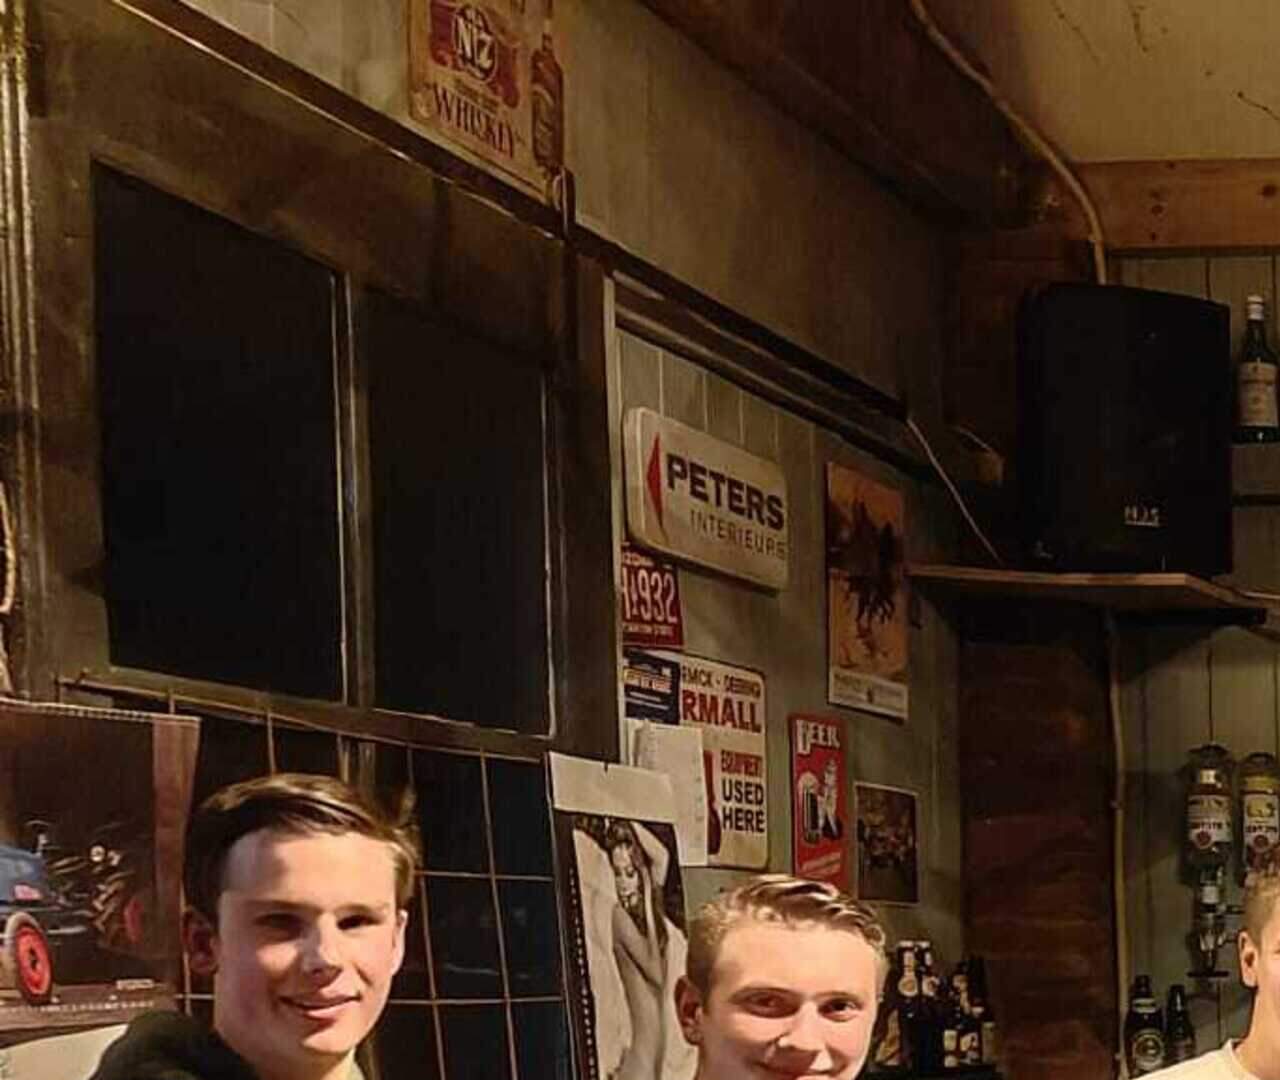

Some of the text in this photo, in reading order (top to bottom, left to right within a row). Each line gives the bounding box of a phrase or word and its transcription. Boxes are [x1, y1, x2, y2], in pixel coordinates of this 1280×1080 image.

[666, 452, 785, 531] PETERS
[682, 689, 762, 734] RMALL
[796, 718, 841, 756] BEER
[721, 777, 764, 806] USED
[721, 806, 766, 833] HERE
